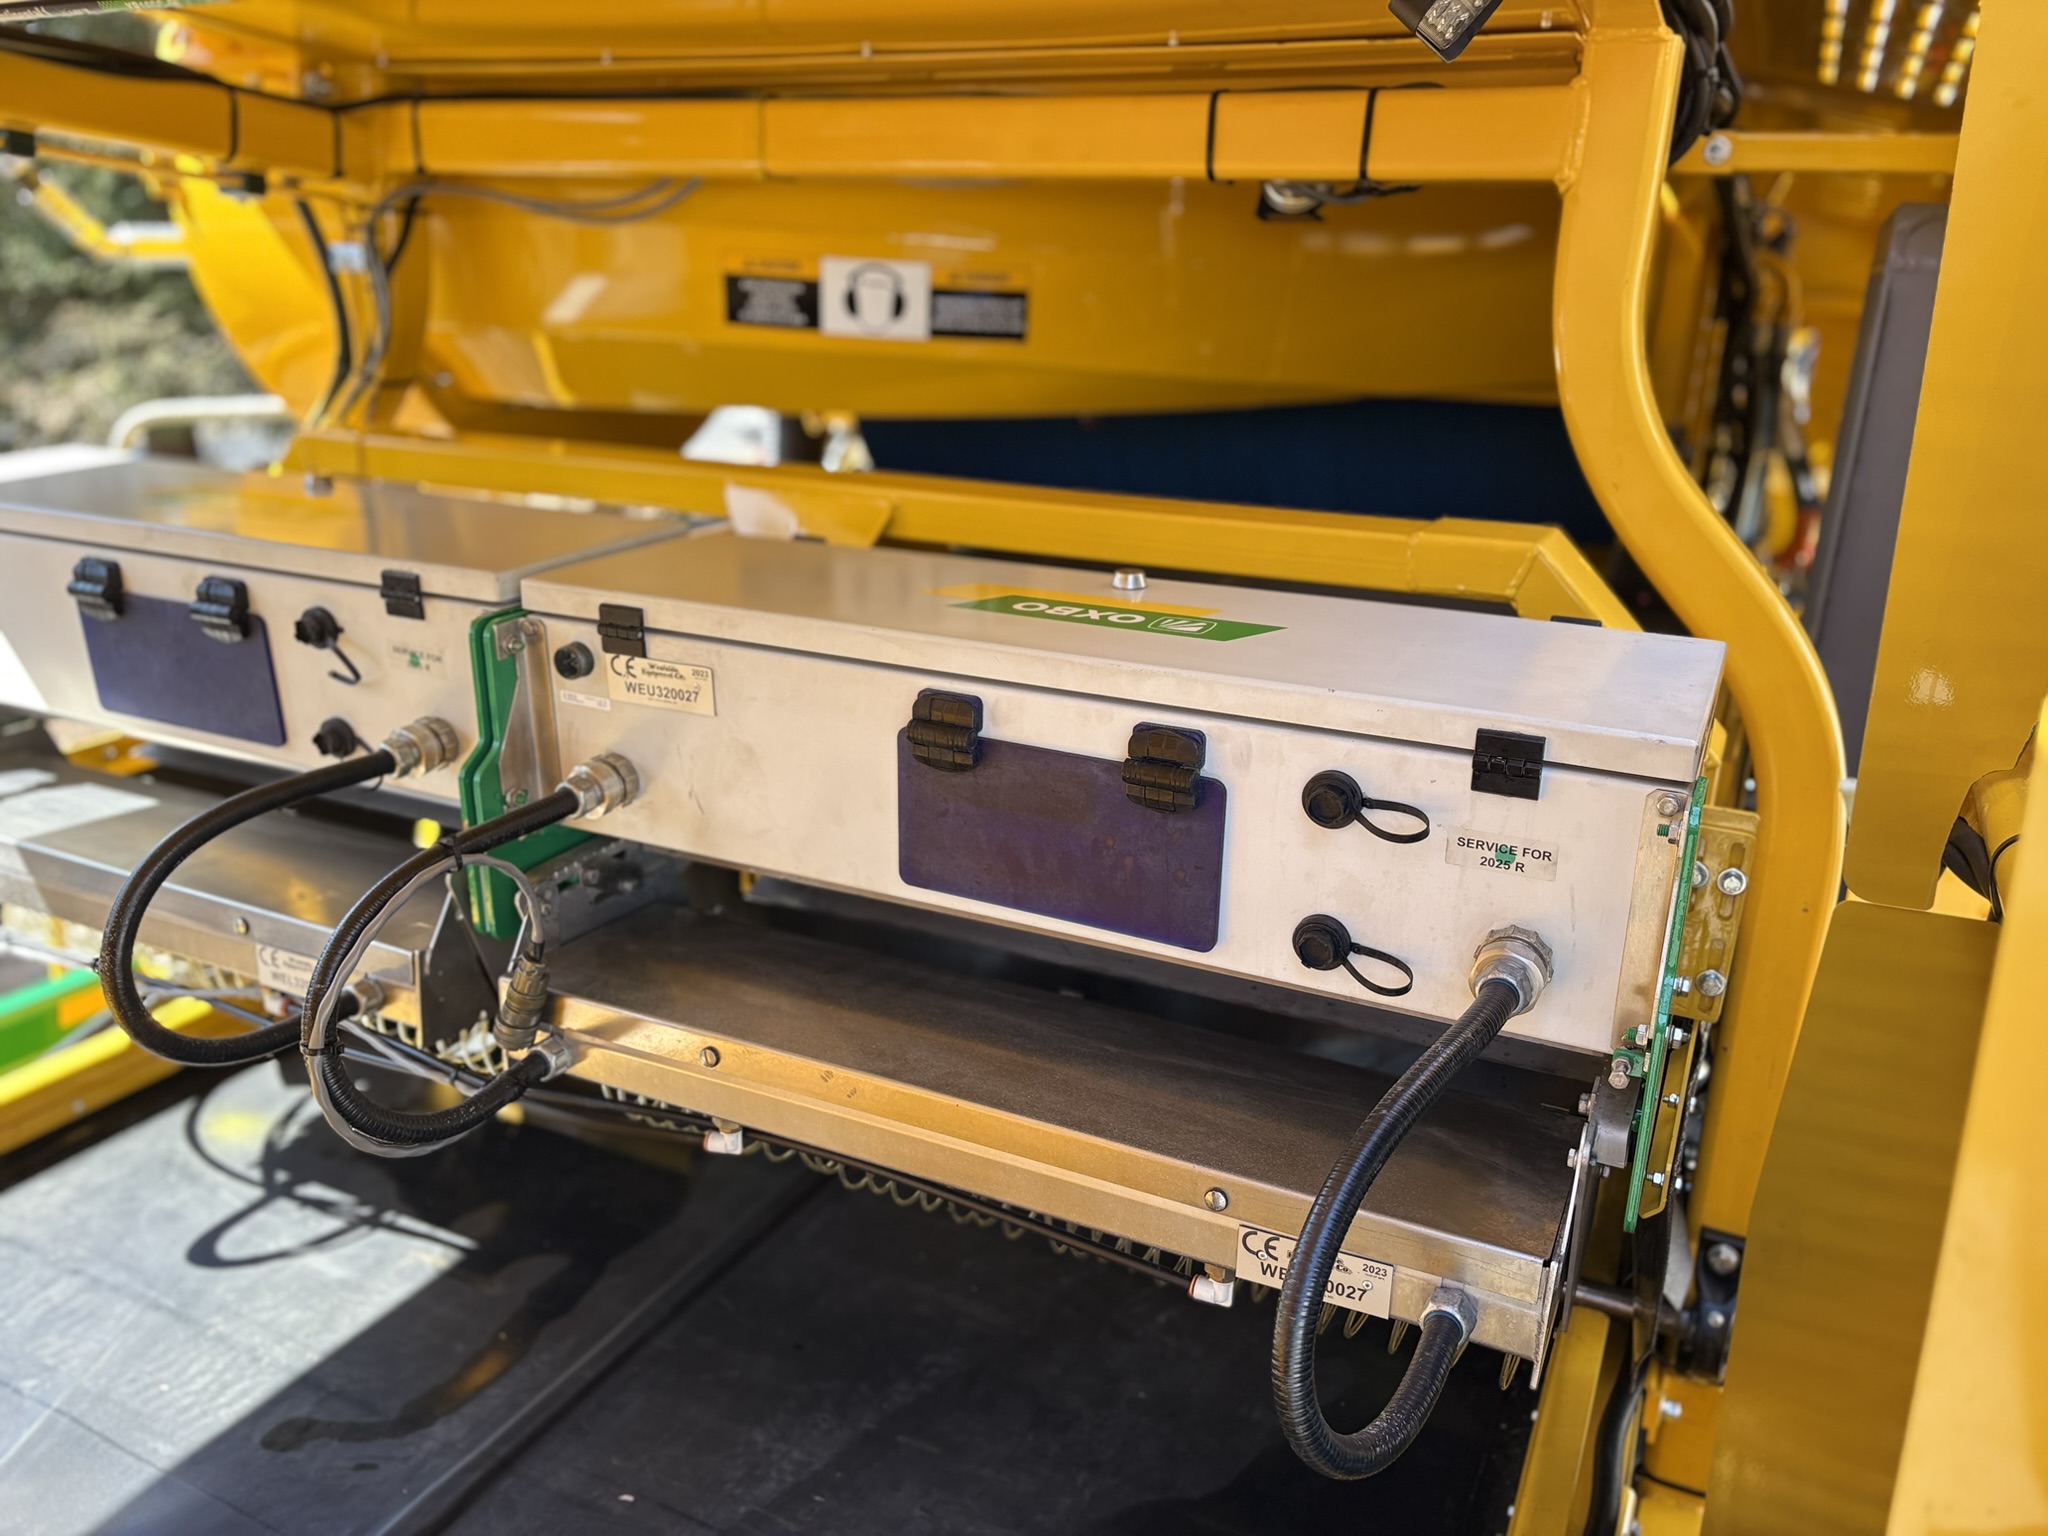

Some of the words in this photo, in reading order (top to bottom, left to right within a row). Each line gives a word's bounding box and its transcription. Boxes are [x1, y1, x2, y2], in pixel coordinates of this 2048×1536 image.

[1012, 602, 1146, 624] OXBO
[610, 655, 637, 679] CE
[691, 669, 709, 679] 2023
[625, 681, 700, 703] WEU320027
[1457, 837, 1518, 856] SERVICE
[1522, 847, 1552, 861] FOR
[1480, 856, 1511, 870] 2025
[1515, 862, 1525, 873] R
[1241, 1230, 1280, 1262] CE
[1260, 1261, 1367, 1302] WE0027
[1362, 1263, 1388, 1278] 2023
